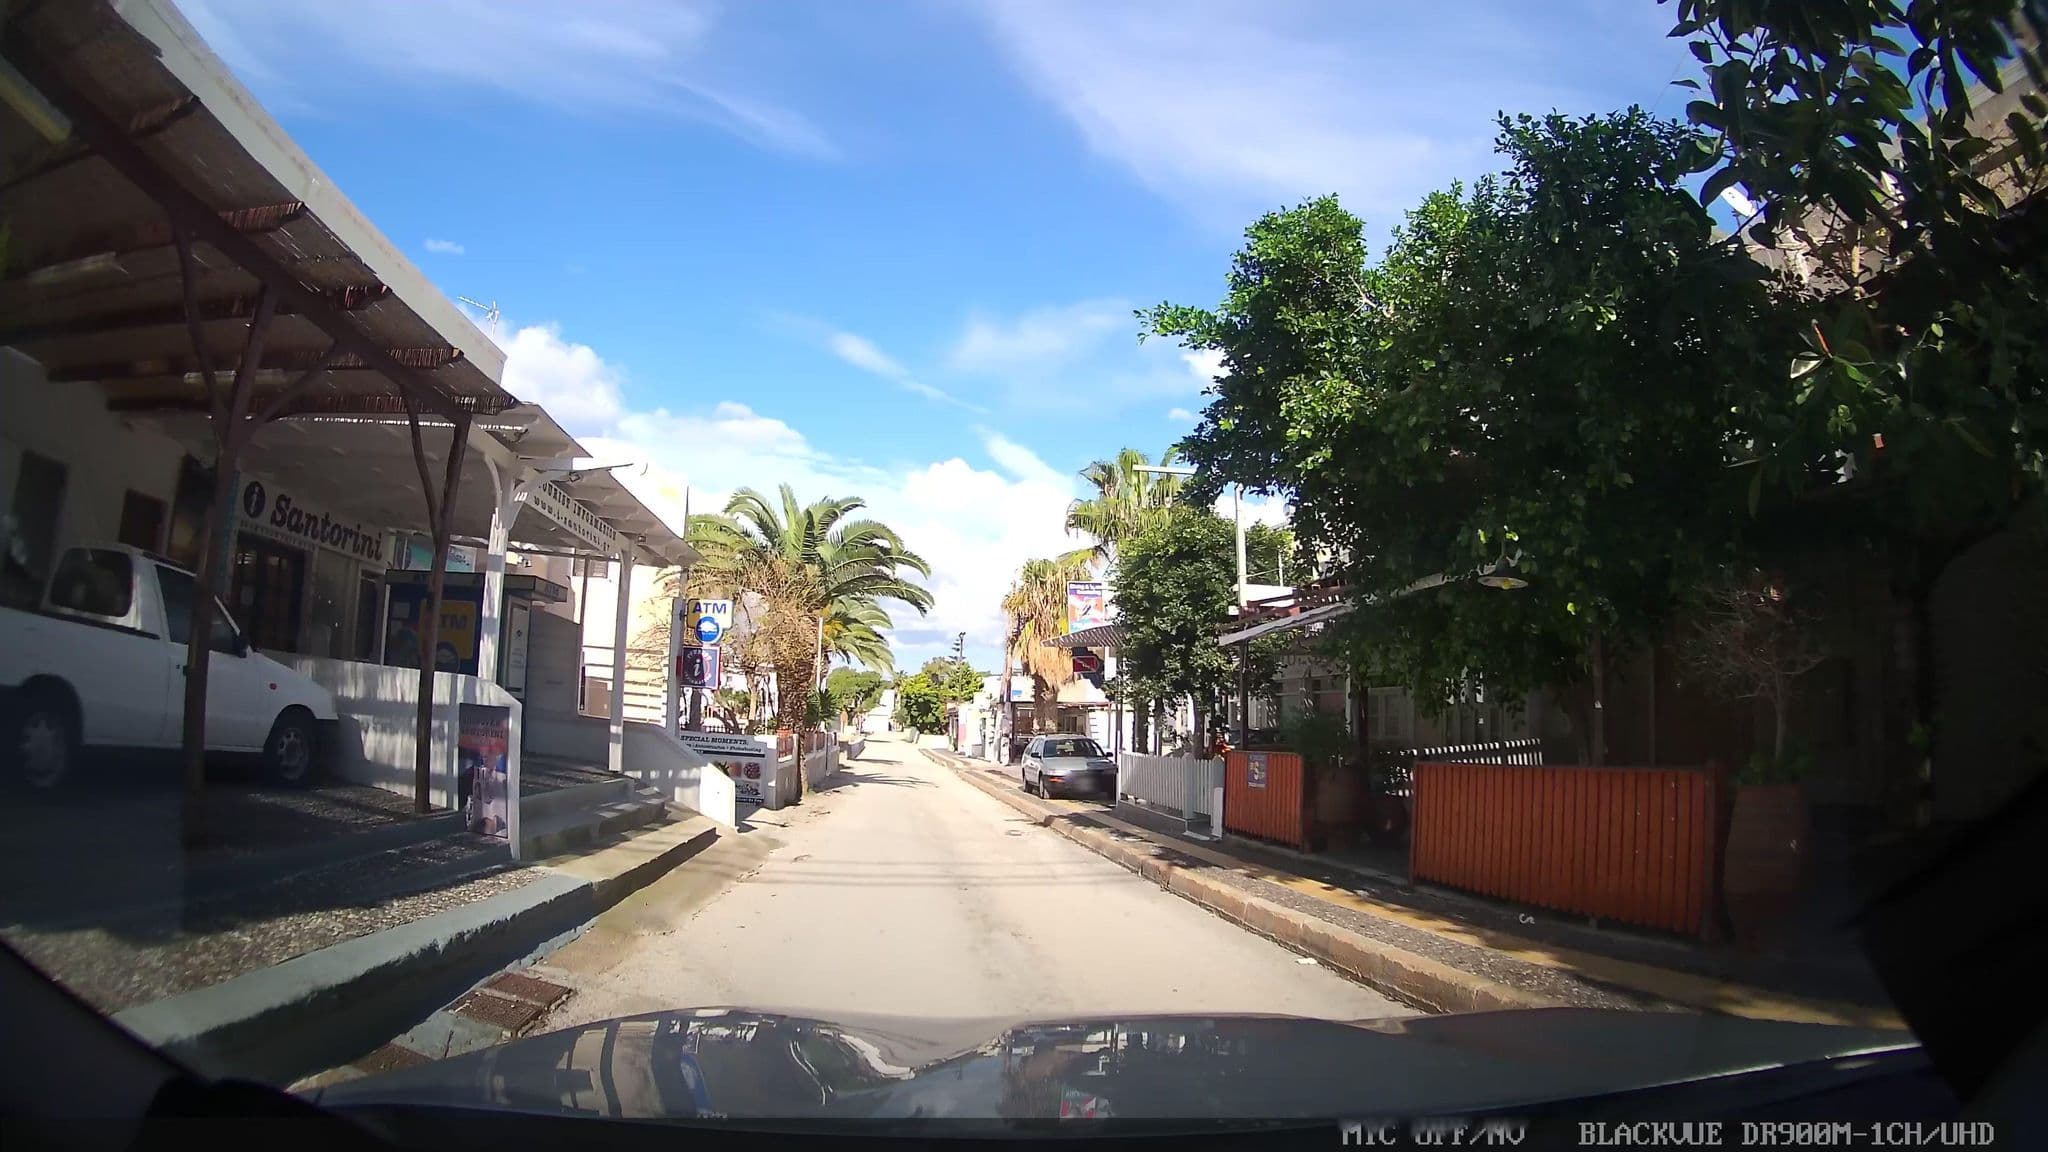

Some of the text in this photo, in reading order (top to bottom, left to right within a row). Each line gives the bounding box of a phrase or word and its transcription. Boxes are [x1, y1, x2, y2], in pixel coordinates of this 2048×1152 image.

[270, 494, 382, 561] Santorini
[538, 482, 617, 541] OURIST INFORMATION
[693, 602, 727, 614] ATM
[680, 735, 710, 744] SPECIAL
